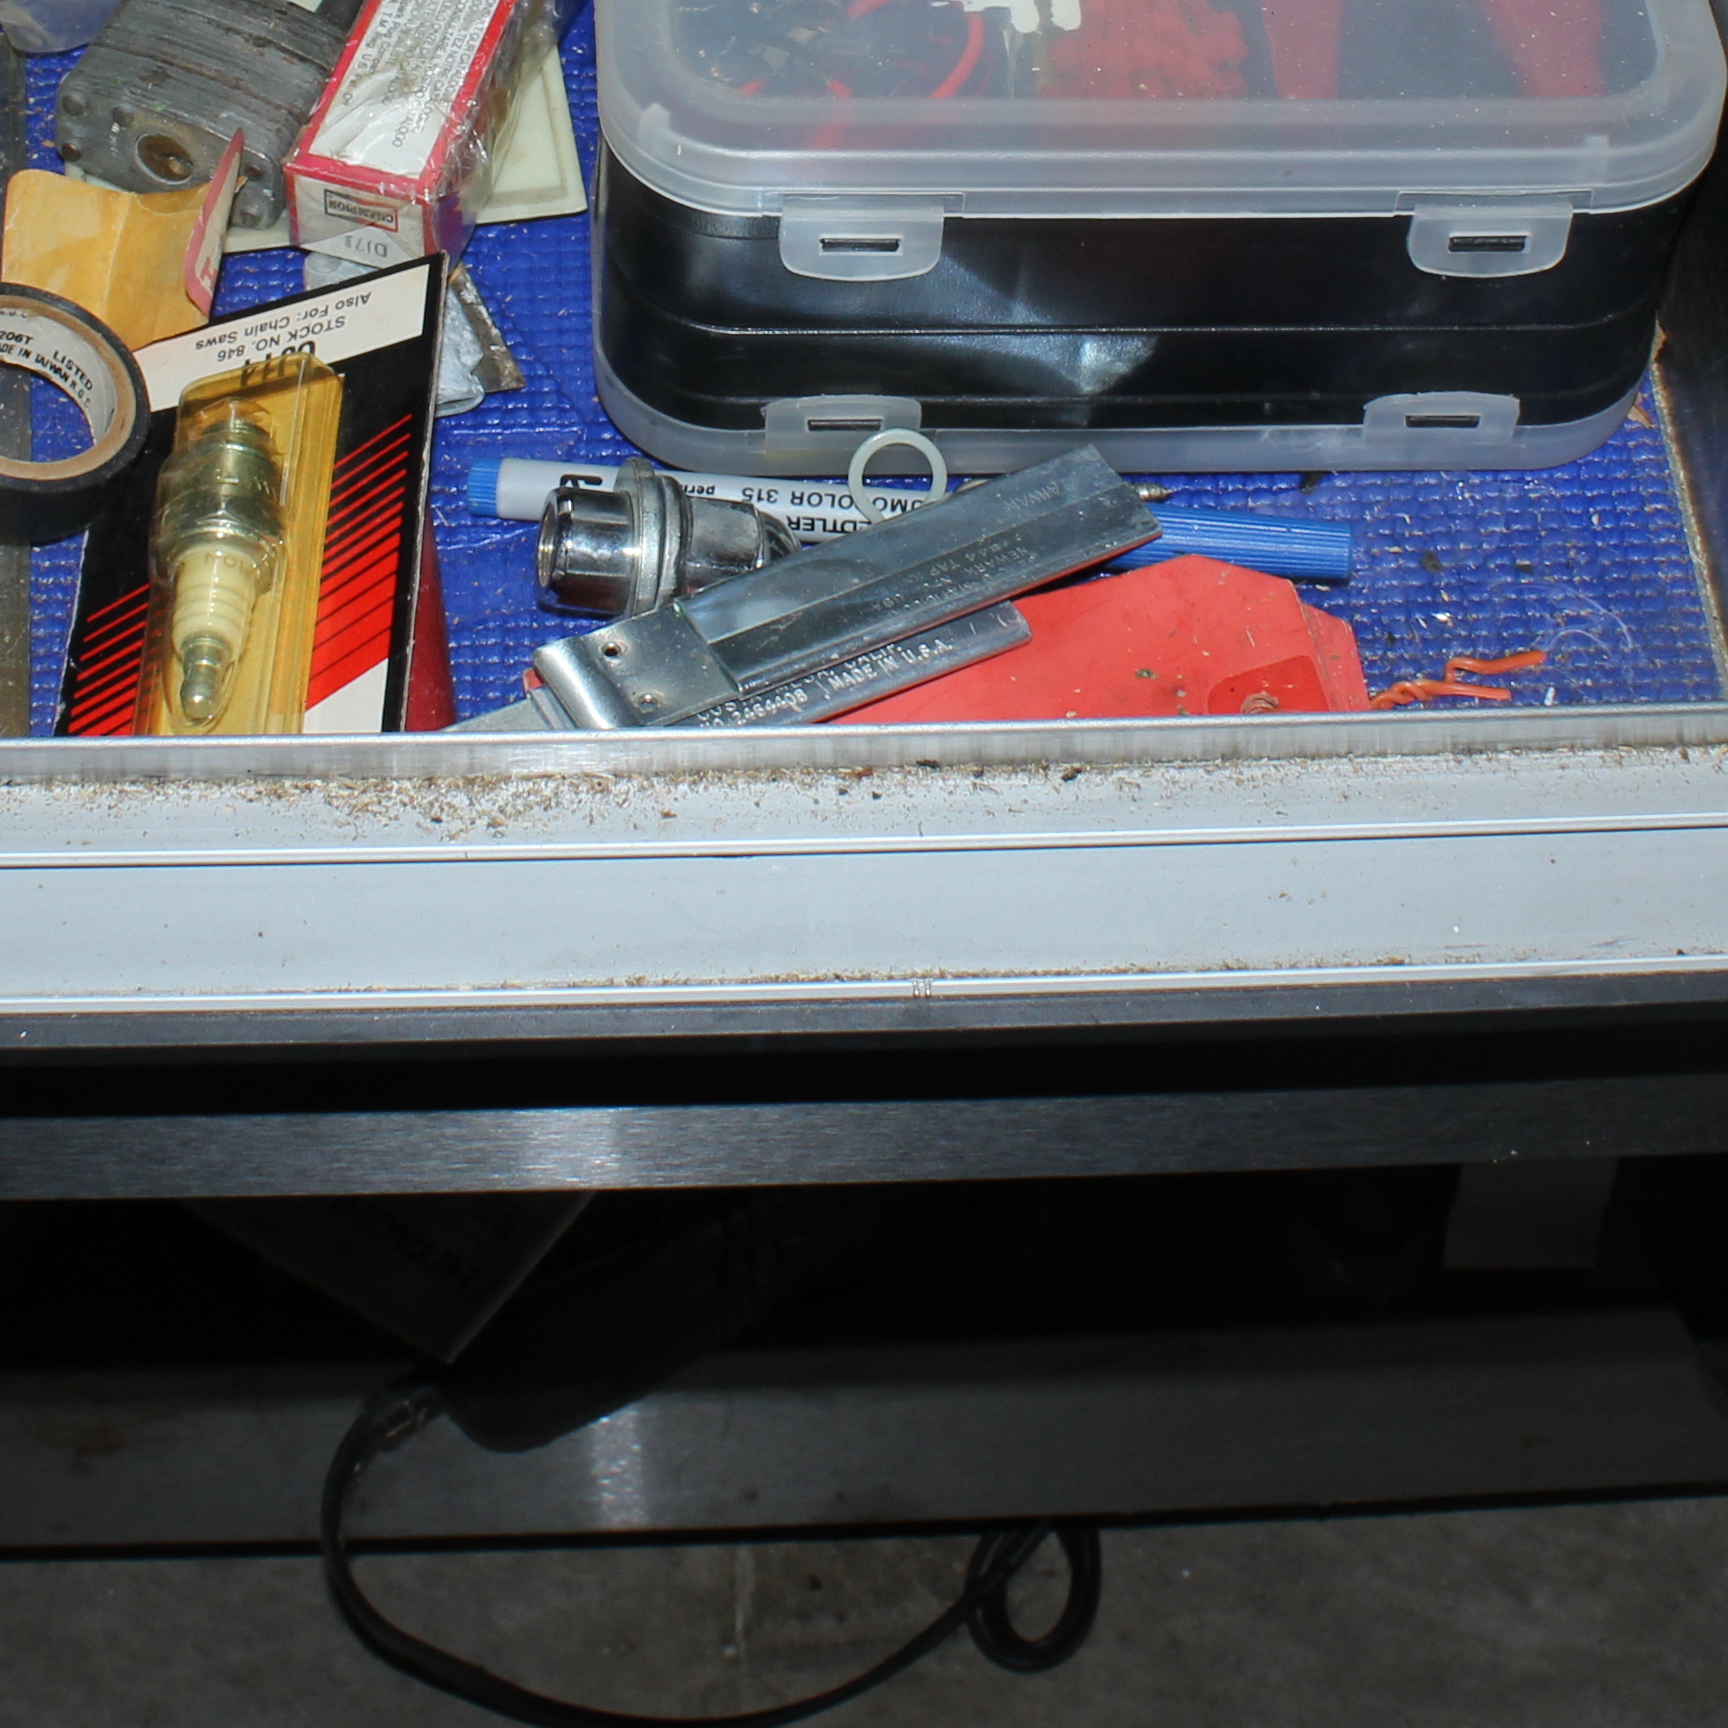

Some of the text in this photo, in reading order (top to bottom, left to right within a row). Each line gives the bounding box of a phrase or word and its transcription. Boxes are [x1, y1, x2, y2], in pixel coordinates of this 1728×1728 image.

[193, 290, 374, 353] Also For: Chain Saws
[213, 313, 347, 363] STOCK NO. 846
[18, 346, 32, 359] IN
[34, 353, 71, 383] TAIWAN
[51, 349, 94, 391] LISTED
[740, 486, 779, 503] 315
[826, 661, 878, 693] MADE
